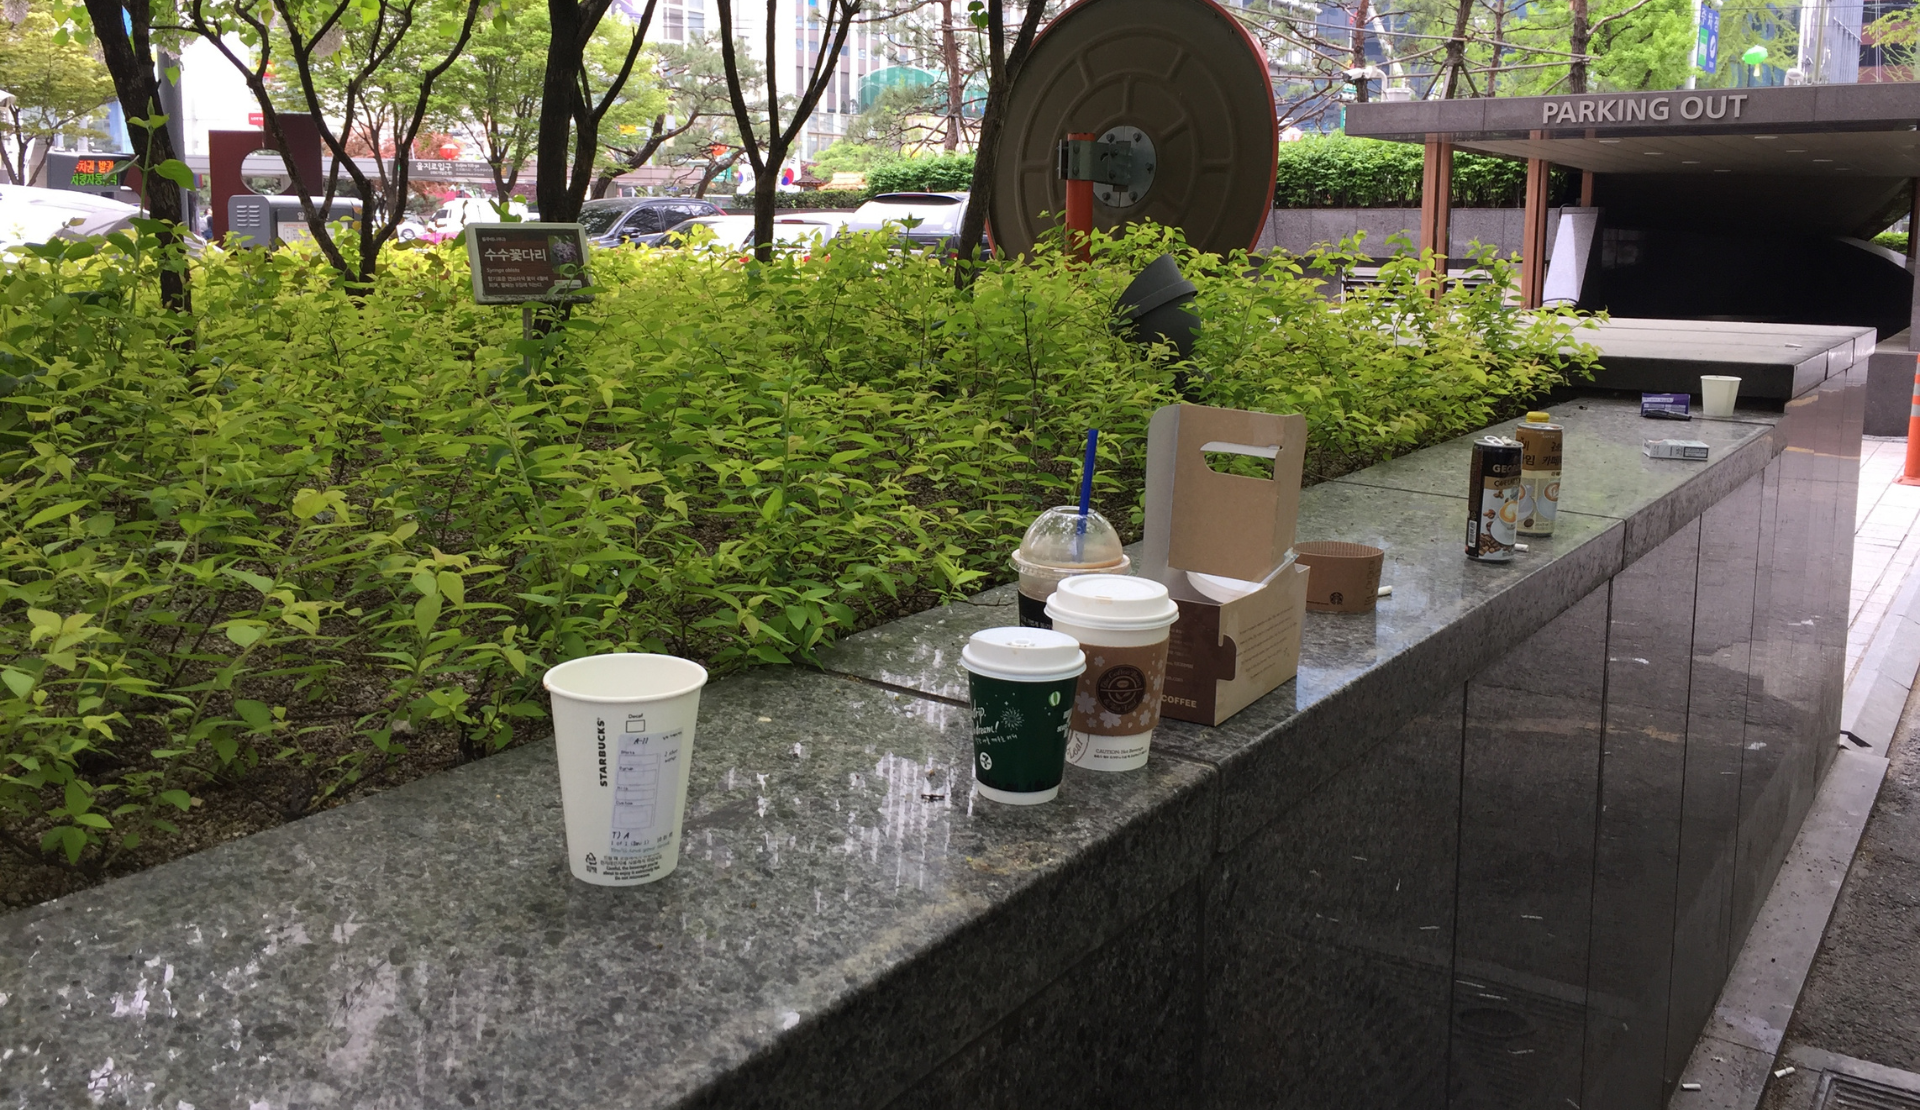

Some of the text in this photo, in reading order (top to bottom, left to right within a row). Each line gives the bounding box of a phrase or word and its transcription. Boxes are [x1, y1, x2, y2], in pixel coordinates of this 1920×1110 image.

[1542, 94, 1748, 124] PARKING OUT
[415, 162, 453, 171] 을지로입구
[484, 248, 547, 262] 수수꽃다리
[1161, 694, 1197, 709] COFFEE
